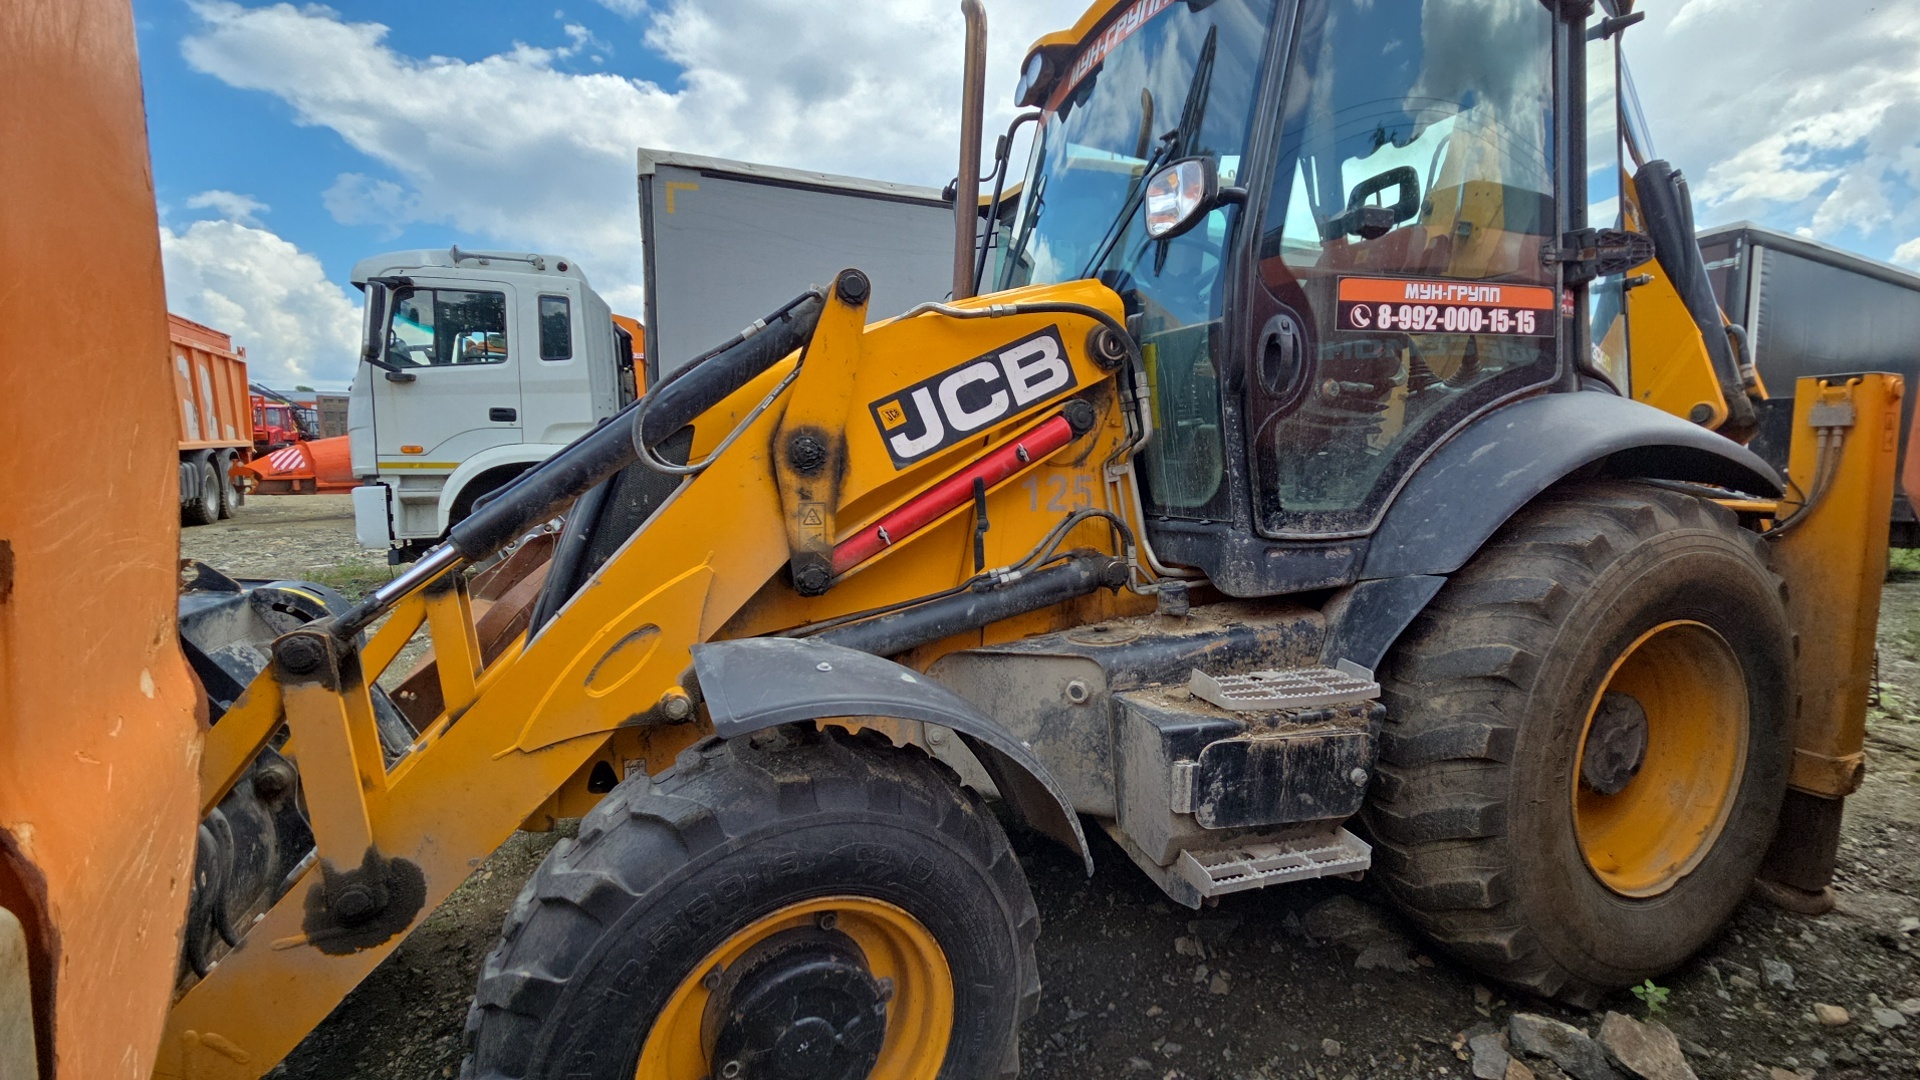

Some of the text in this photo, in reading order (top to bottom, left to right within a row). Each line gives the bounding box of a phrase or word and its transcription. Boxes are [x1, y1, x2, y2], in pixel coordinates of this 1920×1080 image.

[1404, 283, 1501, 303] МУН-ГРУПП
[1377, 304, 1536, 334] 8-992-000-15-15
[889, 335, 1070, 459] JCB
[885, 409, 900, 422] JCB
[1021, 474, 1094, 513] 125
